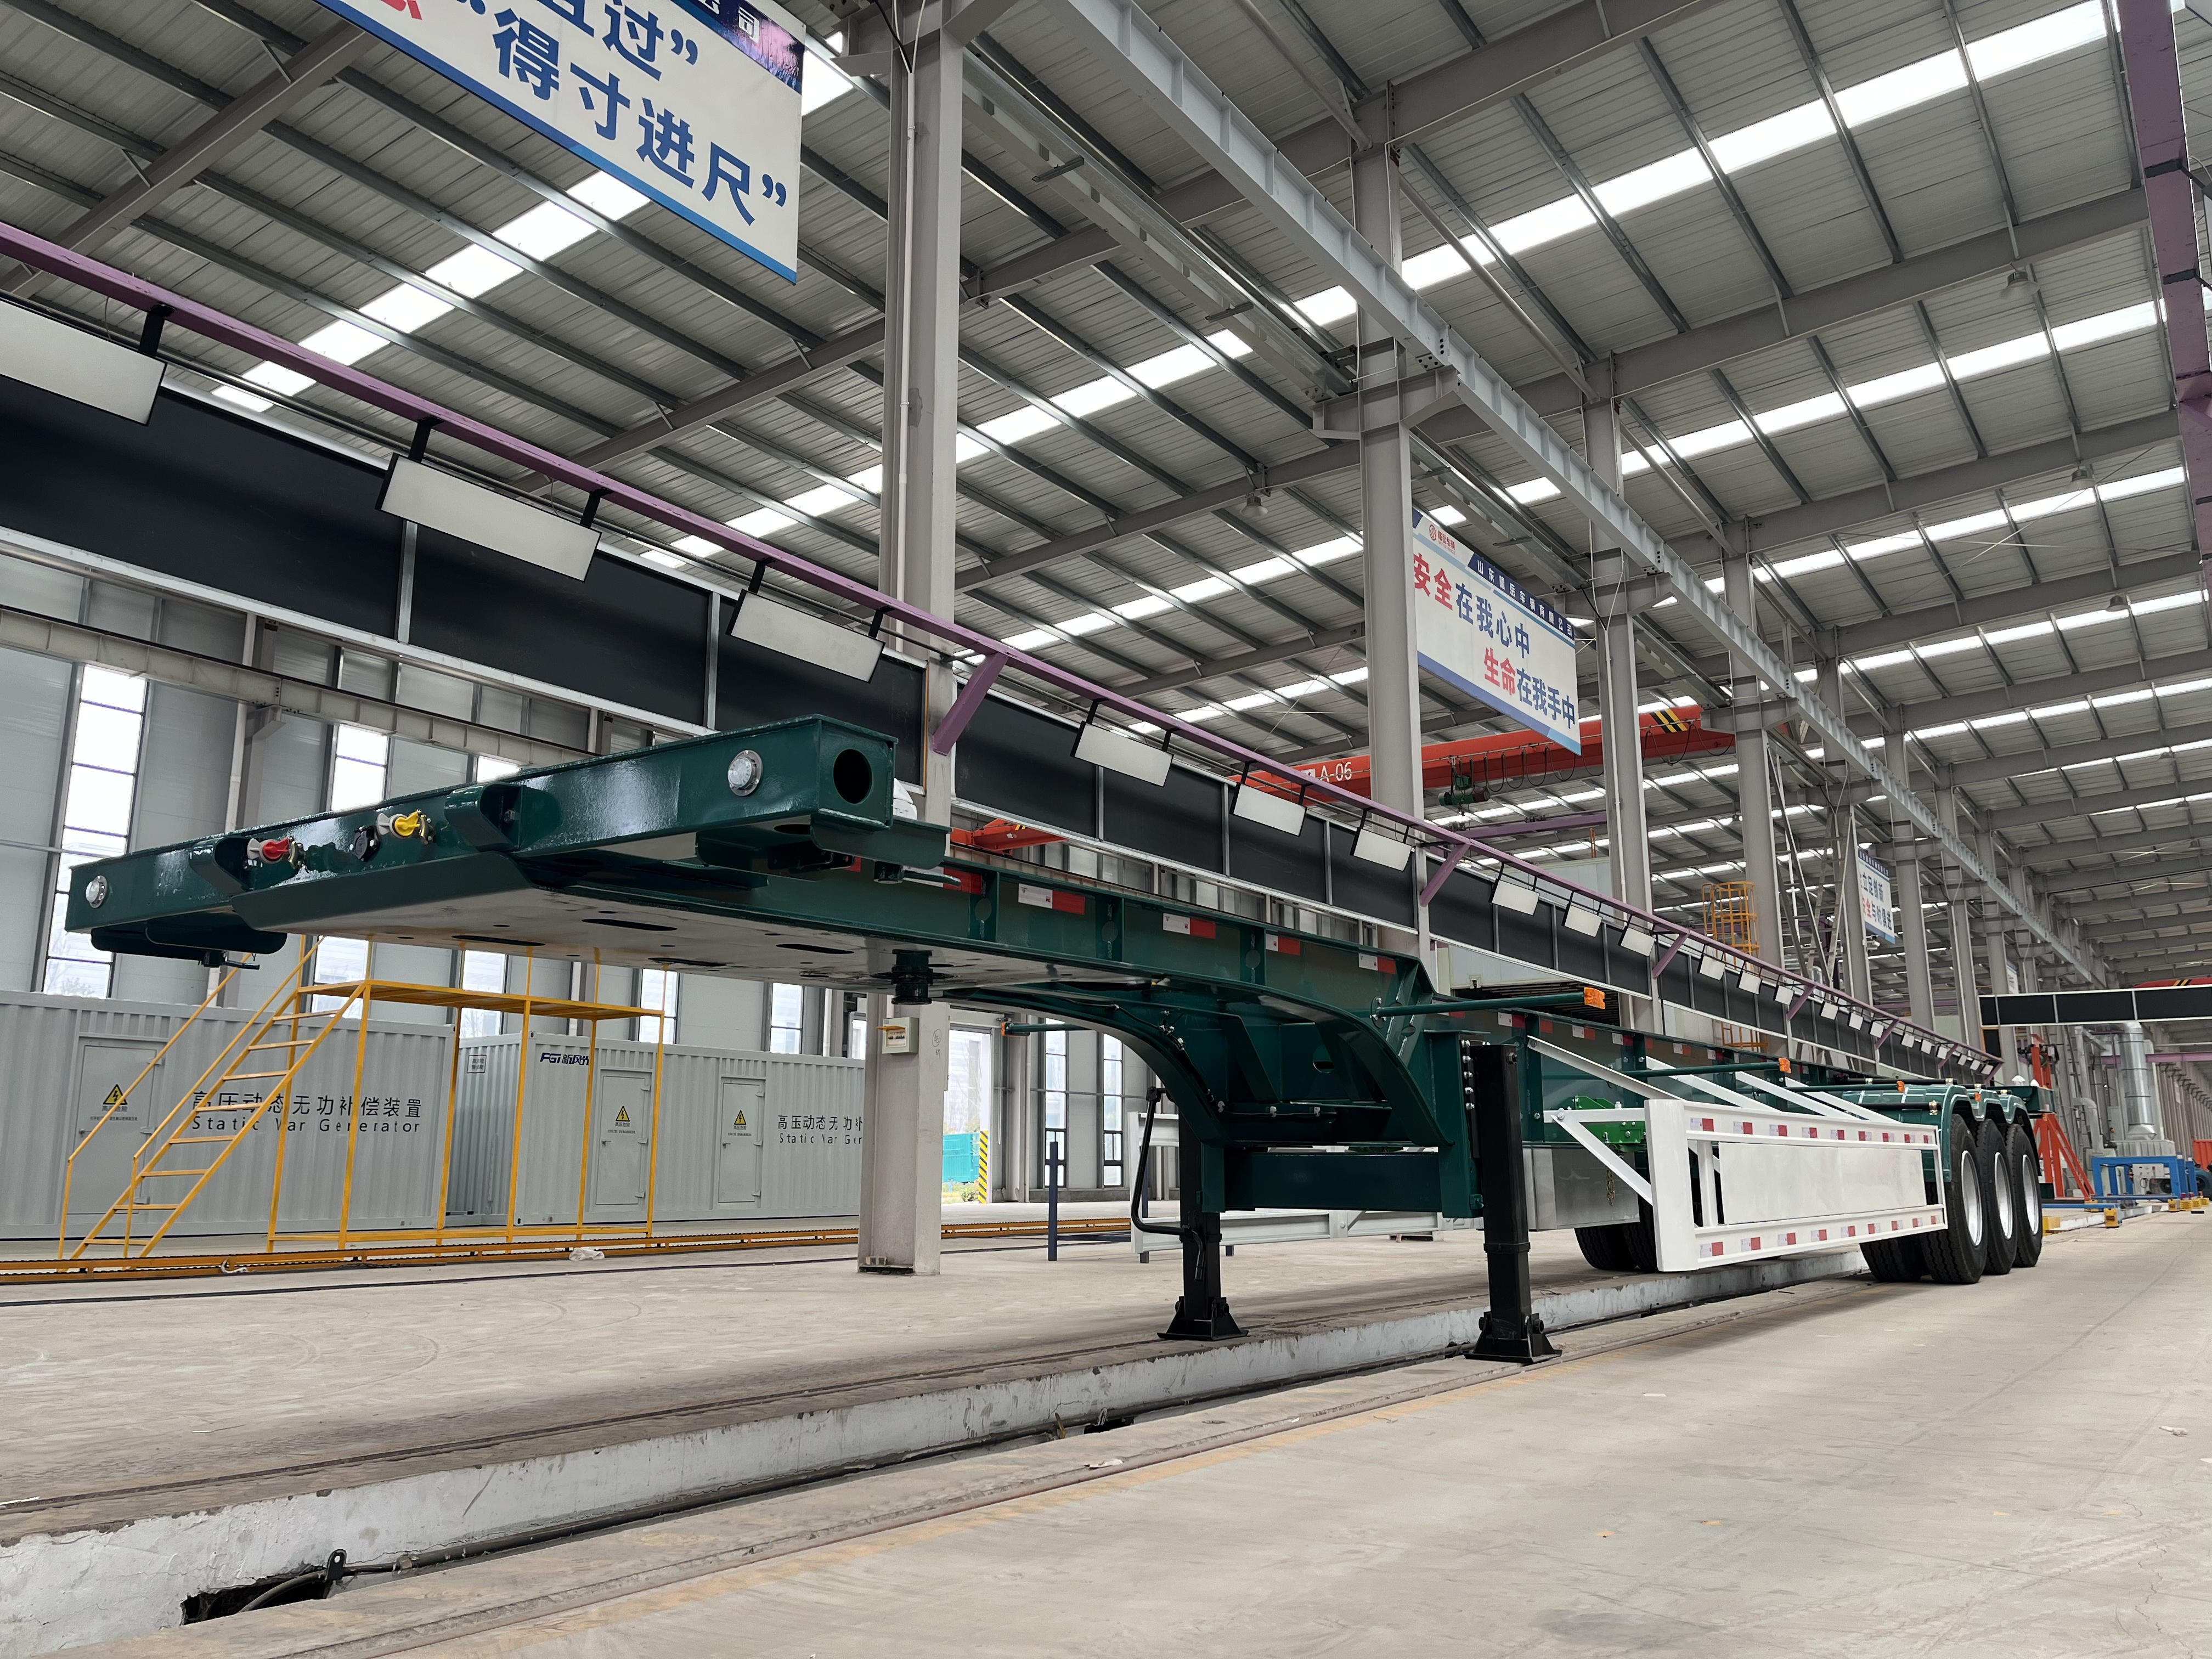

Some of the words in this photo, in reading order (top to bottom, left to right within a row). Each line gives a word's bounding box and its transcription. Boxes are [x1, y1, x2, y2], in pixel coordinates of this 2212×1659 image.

[1413, 552, 1530, 658] 安全在我心中
[1483, 647, 1575, 729] 生命在我手中
[1319, 761, 1352, 783] A-06
[540, 1052, 561, 1064] FGI
[193, 1116, 259, 1131] Static
